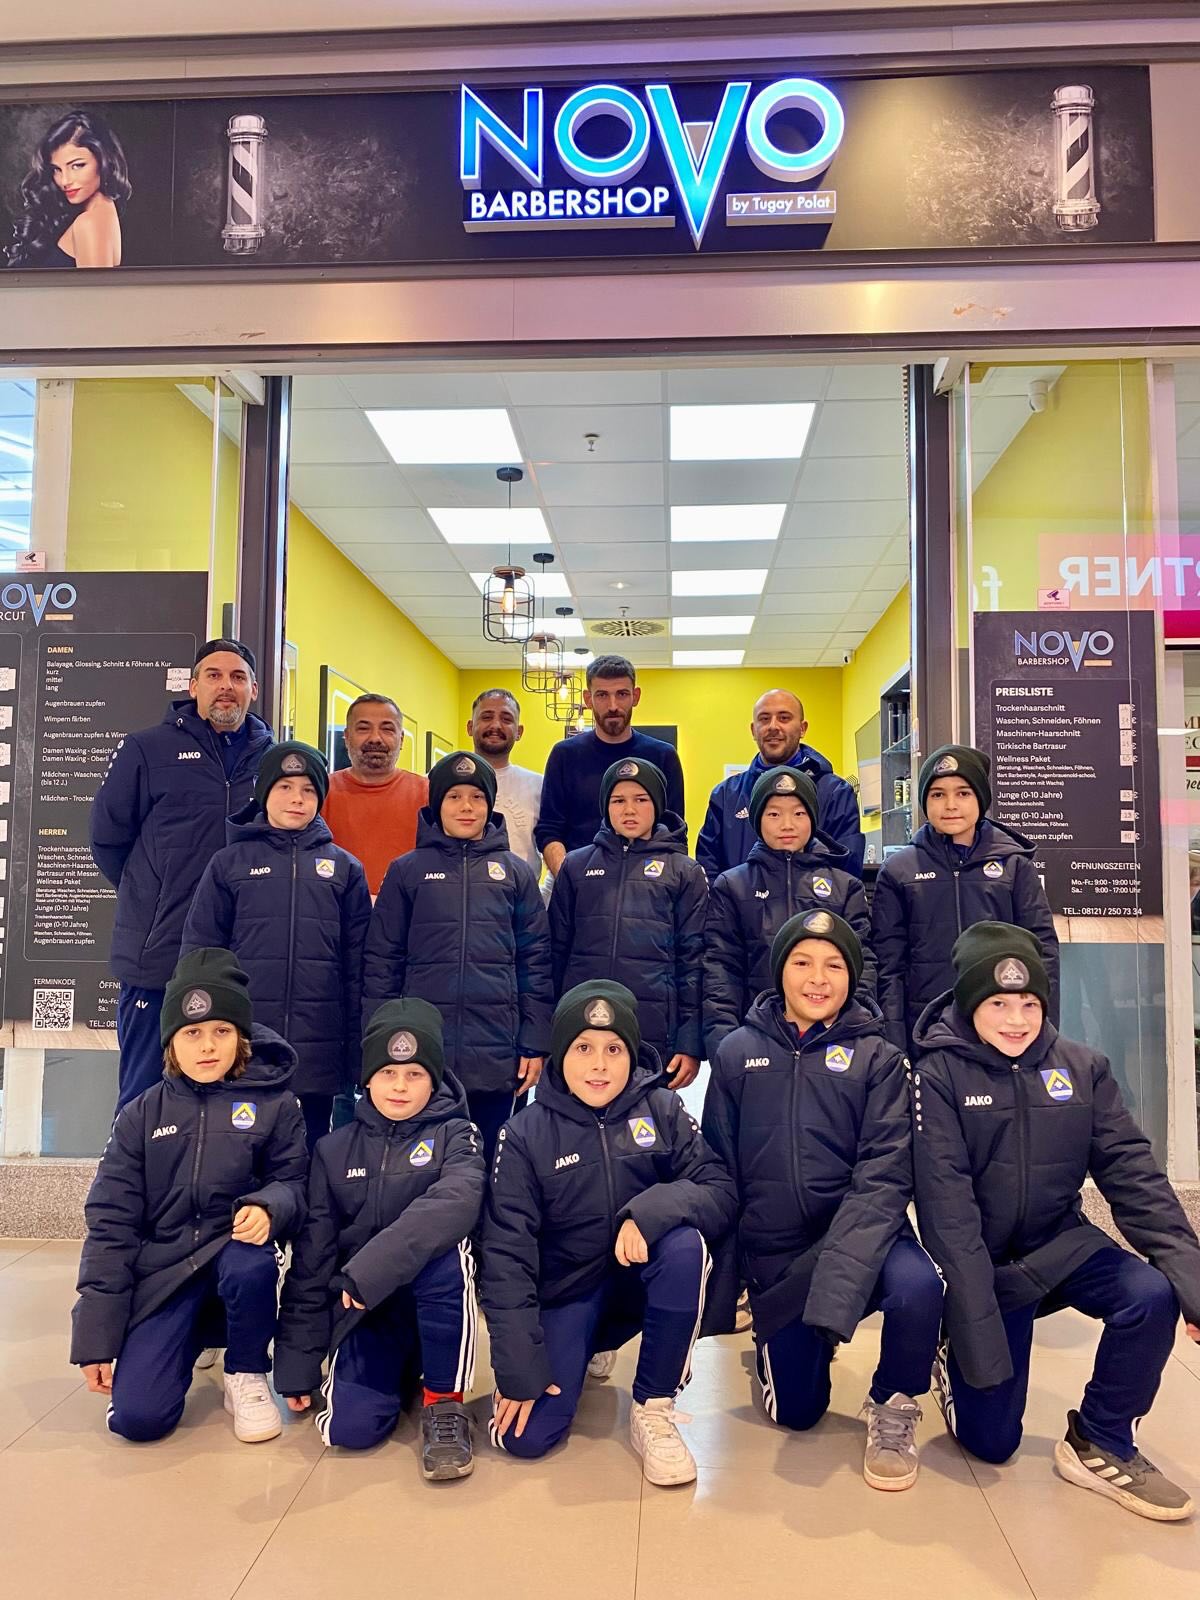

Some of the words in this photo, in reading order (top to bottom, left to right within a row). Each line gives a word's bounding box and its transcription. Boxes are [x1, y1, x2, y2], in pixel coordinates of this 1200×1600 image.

[460, 78, 845, 246] NOVO
[471, 187, 670, 218] BARBERSHOP
[732, 197, 750, 214] by
[752, 196, 794, 213] Tugay
[797, 194, 831, 209] Polat
[1, 583, 77, 627] OVO
[47, 646, 74, 654] DAMEN
[1014, 629, 1114, 672] NOVO
[46, 660, 74, 669] Balayage,
[75, 660, 102, 669] Glossing,
[103, 660, 124, 669] Schnitt
[131, 660, 154, 669] Föhnen
[160, 660, 172, 669] Kur
[1017, 657, 1070, 666] BARBERSHOP
[45, 684, 59, 692] lang
[995, 687, 1054, 696] PREISLISTE
[44, 700, 84, 708] Augenbrauen
[85, 700, 106, 708] zupfen
[43, 715, 71, 723] Wimpern
[71, 715, 91, 723] färben
[995, 716, 1031, 725] Waschen,
[1031, 716, 1072, 725] Schneiden,
[1073, 716, 1101, 725] Föhnen
[996, 729, 1081, 737] Maschinen-Haarschnitt
[996, 742, 1032, 750] Türkische
[1032, 742, 1067, 750] Bartrasur
[42, 747, 64, 755] Damen
[65, 747, 87, 755] Waxing
[177, 751, 201, 759] JAKO
[42, 755, 64, 763] Damen
[65, 755, 87, 763] Waxing
[996, 755, 1029, 763] Wellness
[1030, 755, 1051, 763] Paket
[997, 791, 1020, 799] Junge
[1020, 791, 1039, 799] (0-10
[1039, 791, 1063, 799] Jahre)
[997, 812, 1020, 820] Junge
[1021, 812, 1039, 820] (0-10
[1040, 812, 1064, 820] Jahre)
[38, 828, 68, 836] HERREN
[1048, 832, 1073, 840] zupfen
[37, 853, 66, 861] Waschen,
[1070, 861, 1141, 869] ÖFFNUNGSZEITEN
[249, 866, 271, 875] JAKO
[425, 872, 446, 880] JAKO
[914, 871, 936, 880] JAKO
[1062, 907, 1081, 915] TEL.:
[1081, 907, 1102, 915] 08121
[1107, 907, 1122, 915] 250
[1122, 907, 1132, 915] 73
[1132, 907, 1142, 915] 34
[33, 921, 53, 929] Junge
[53, 921, 68, 929] (0-10
[69, 921, 88, 929] Jahre)
[33, 937, 73, 945] Augenbrauen
[74, 937, 95, 945] zupfen
[89, 1020, 106, 1028] TEL.:
[106, 1020, 118, 1028] 081
[744, 1057, 770, 1068] JAKO
[964, 1095, 993, 1106] JAKO
[151, 1125, 178, 1139] JAKO
[554, 1153, 580, 1169] JAKO
[346, 1168, 366, 1178] JAK
